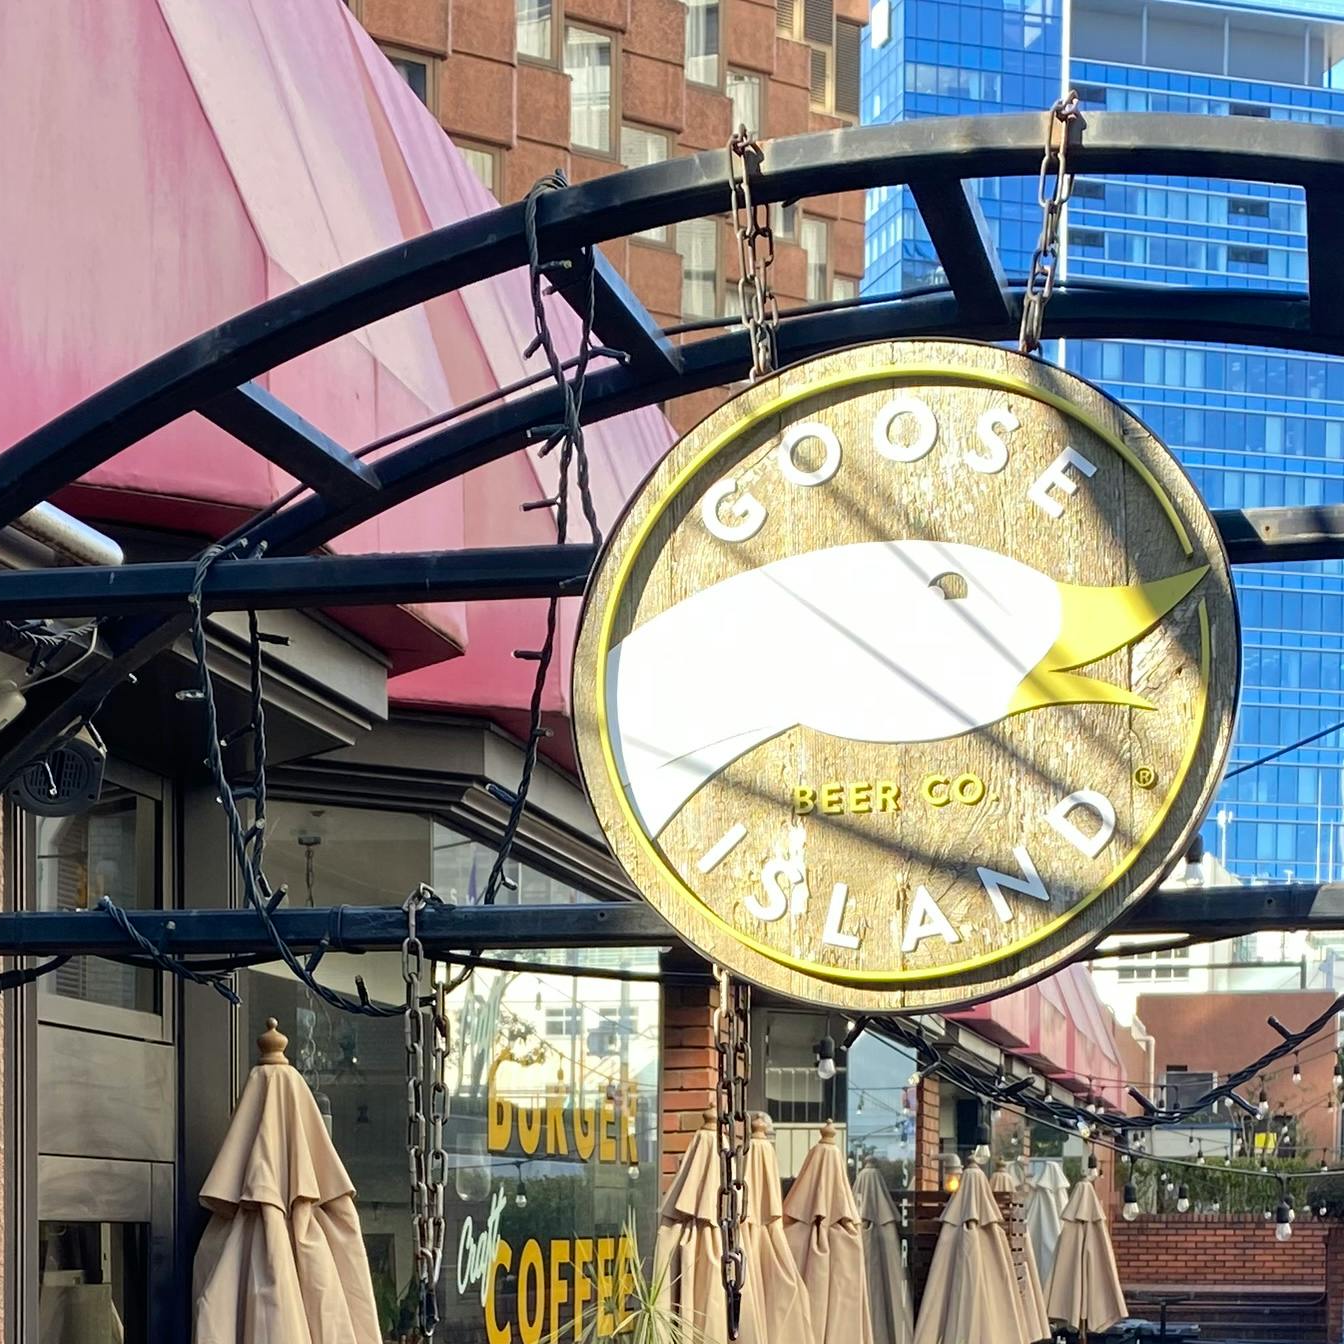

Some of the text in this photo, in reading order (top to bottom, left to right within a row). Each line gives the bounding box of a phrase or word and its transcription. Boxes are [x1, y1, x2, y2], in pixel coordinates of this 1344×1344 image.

[701, 395, 1098, 543] GOOSE
[793, 772, 998, 816] BEER CO.
[697, 789, 1117, 952] ISLAND
[458, 1182, 507, 1307] Craft
